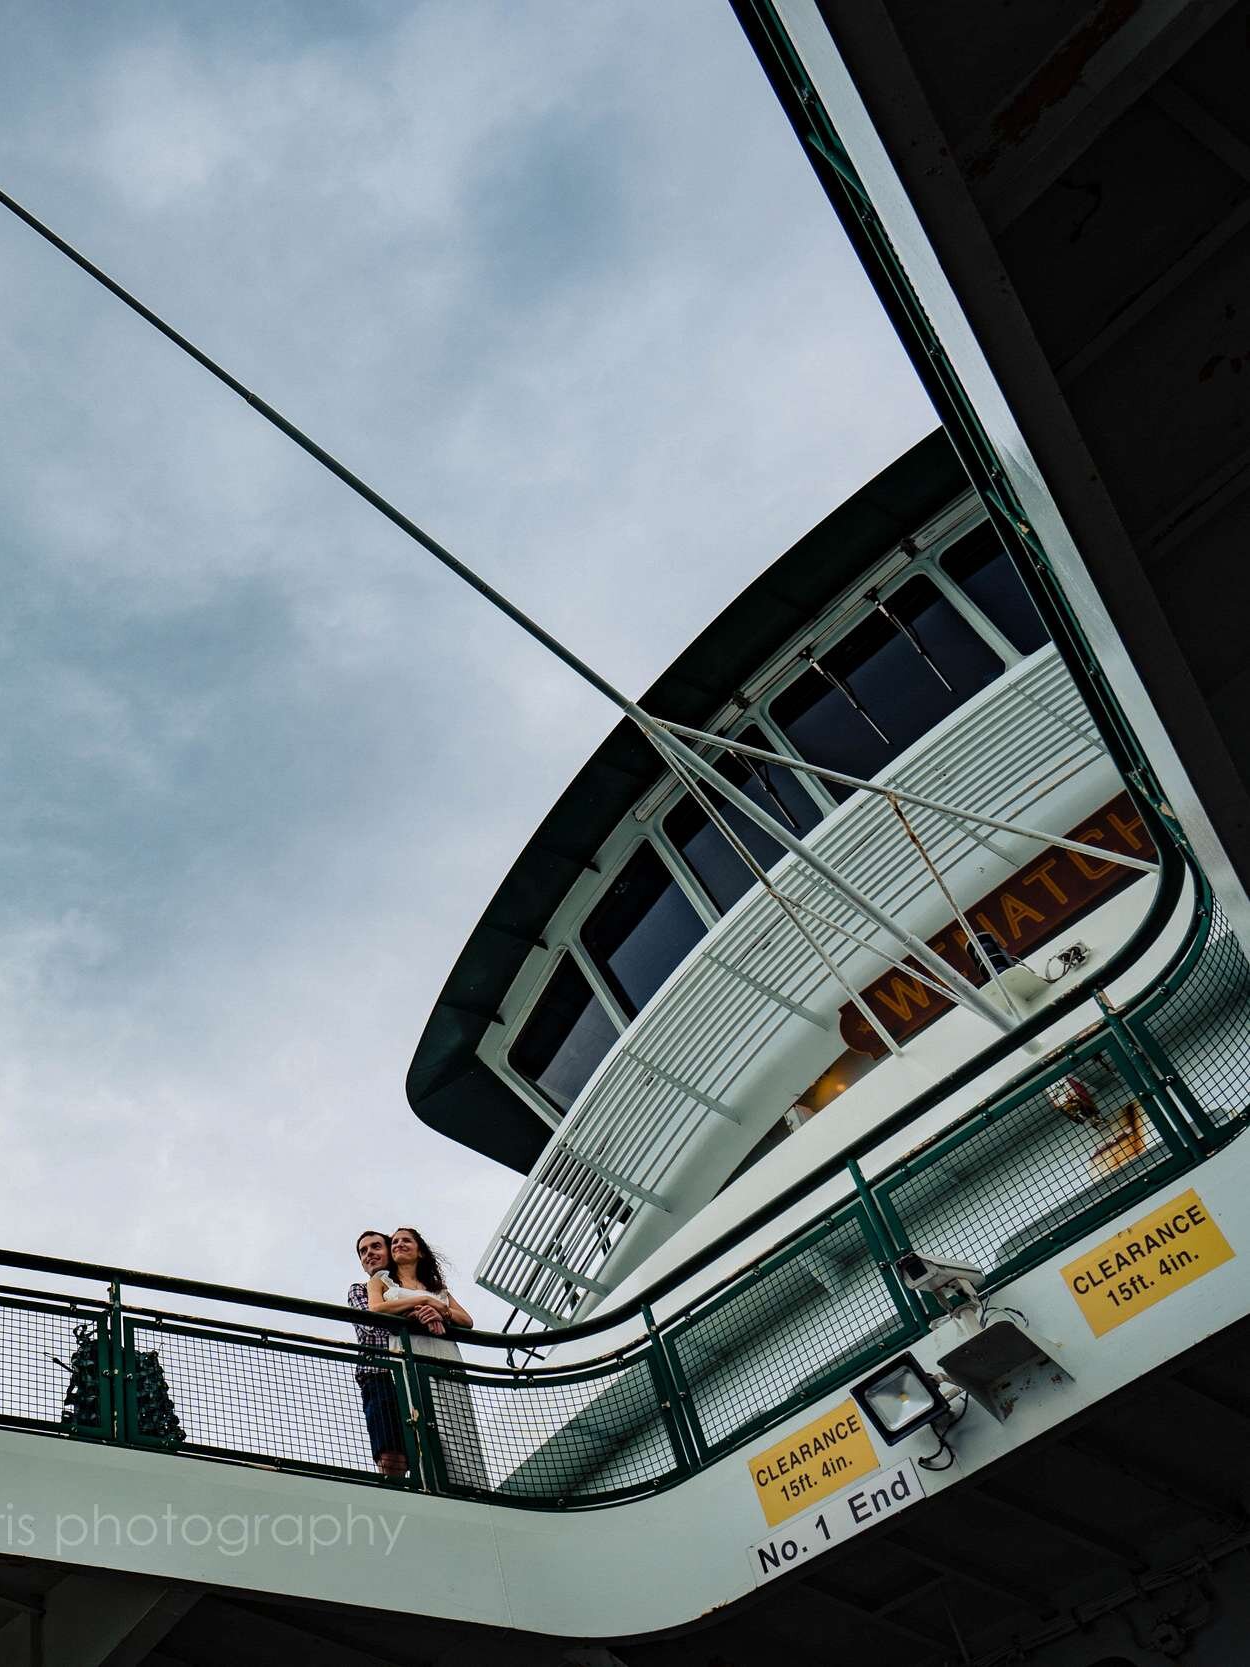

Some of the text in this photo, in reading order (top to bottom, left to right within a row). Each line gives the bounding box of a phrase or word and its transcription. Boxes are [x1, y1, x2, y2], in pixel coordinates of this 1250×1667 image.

[1073, 1204, 1206, 1295] CLEARANCE
[1107, 1249, 1199, 1306] 15ft. 4in.
[756, 1414, 861, 1487] CLEARANCE
[780, 1455, 853, 1501] 15ft. 4in.
[757, 1471, 911, 1574] No. 1 End
